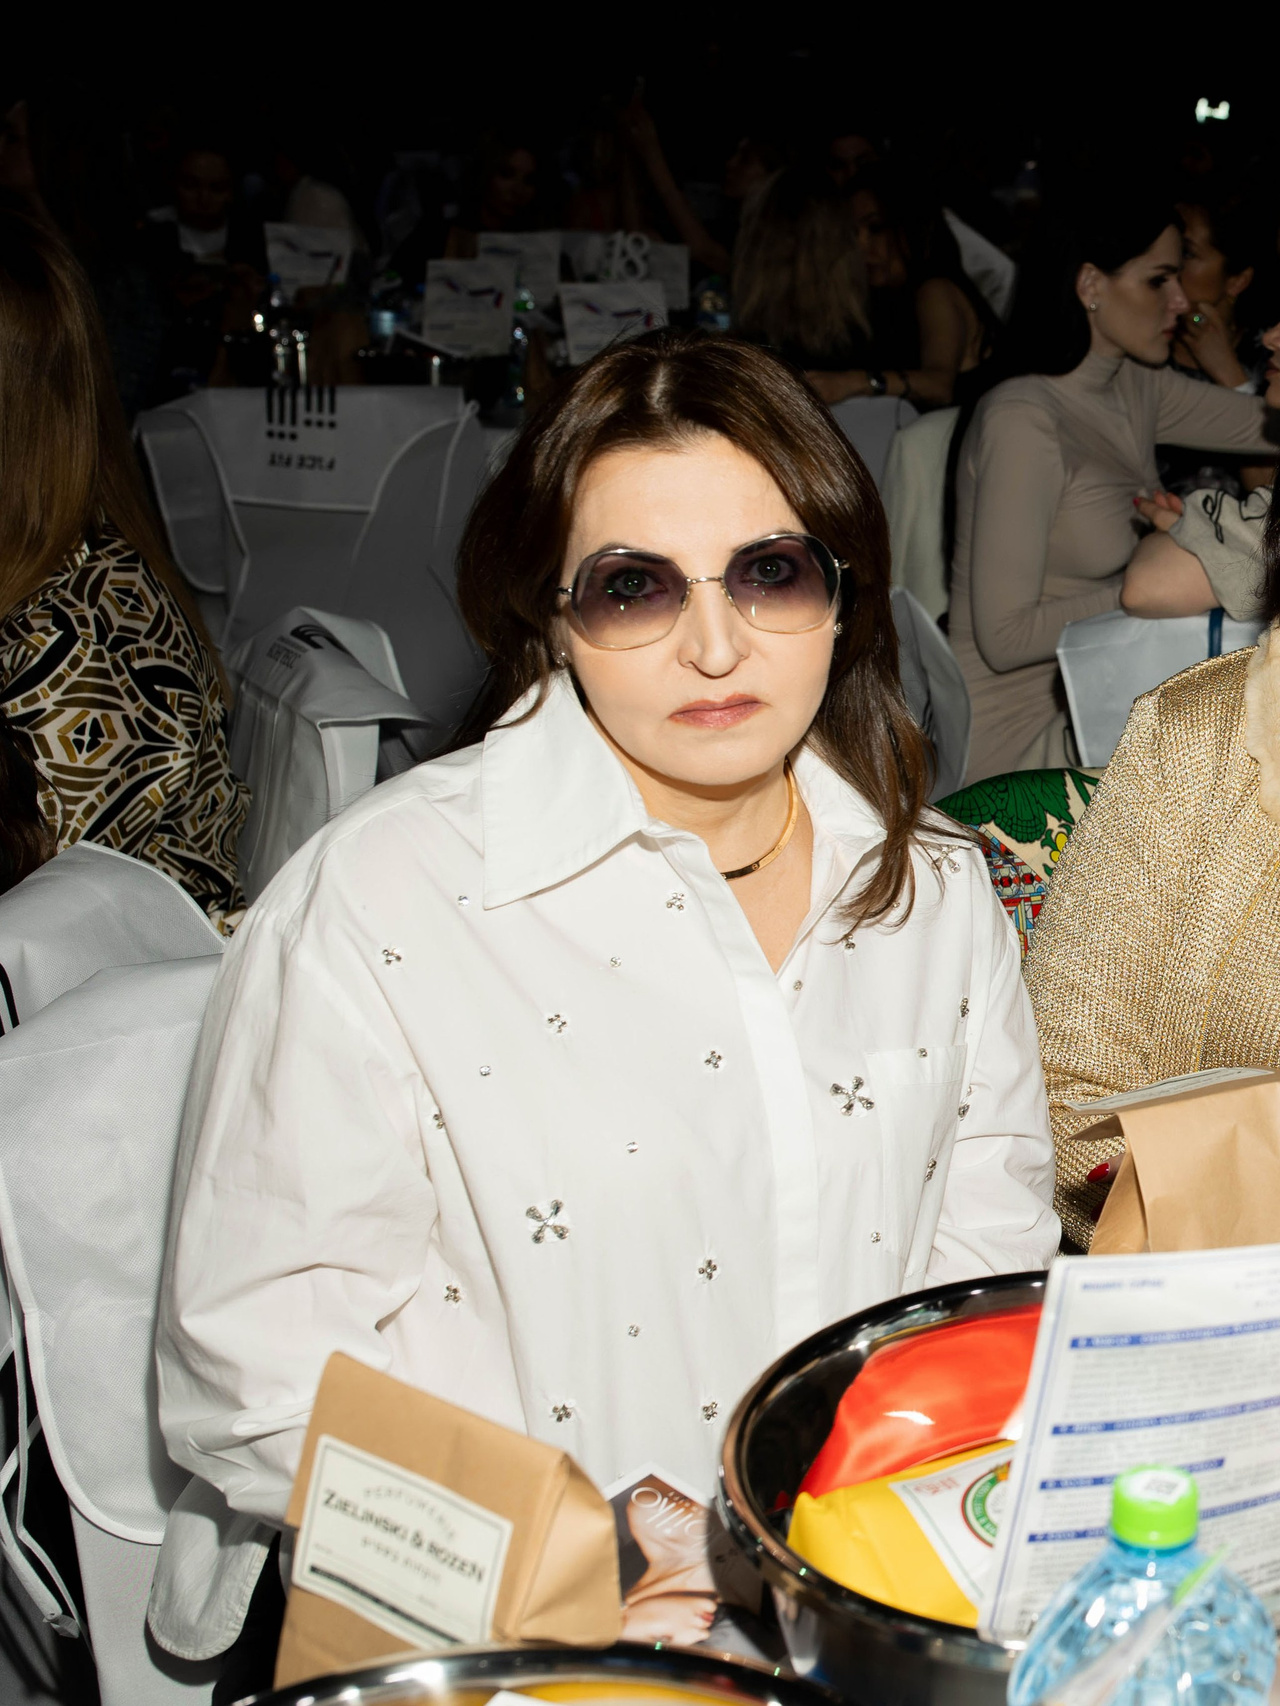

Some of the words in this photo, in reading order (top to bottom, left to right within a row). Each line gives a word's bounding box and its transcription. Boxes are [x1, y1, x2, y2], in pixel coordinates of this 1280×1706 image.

[610, 229, 650, 280] 18
[267, 453, 293, 467] FIT
[409, 1532, 424, 1550] &
[425, 1537, 485, 1583] ROZEN
